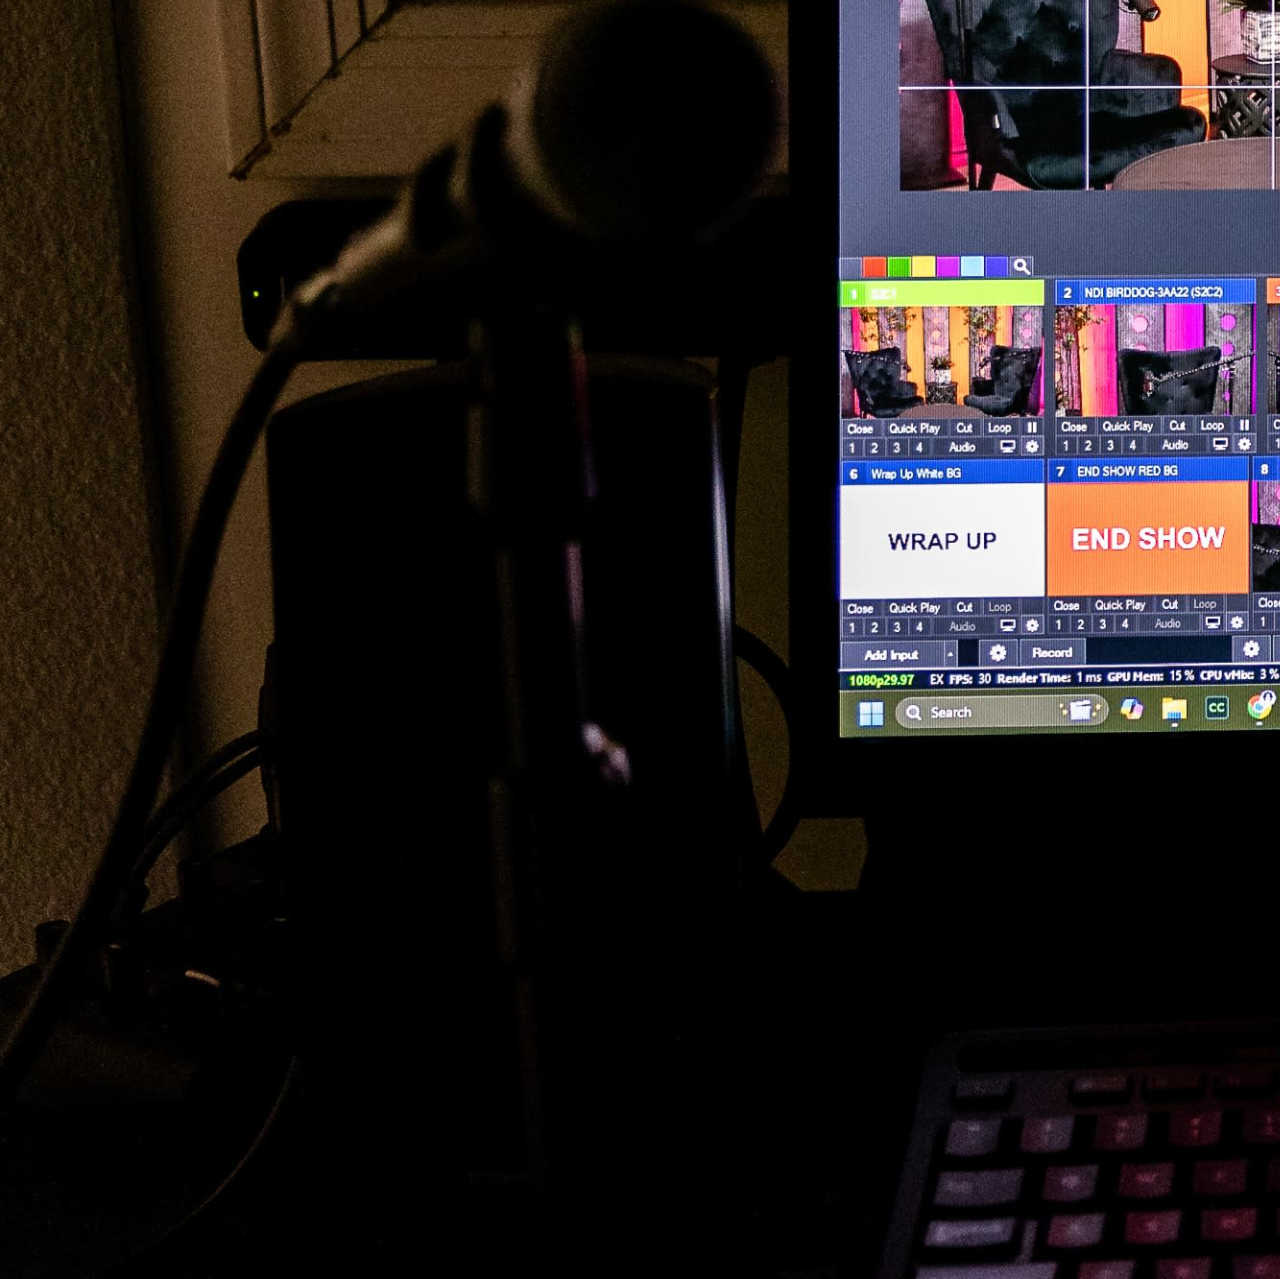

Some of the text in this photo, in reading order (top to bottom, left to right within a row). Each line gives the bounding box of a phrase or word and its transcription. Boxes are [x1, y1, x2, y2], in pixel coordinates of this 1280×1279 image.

[1064, 288, 1072, 298] 2
[1085, 287, 1103, 297] NDI
[1191, 286, 1223, 298] (S2C2)
[847, 423, 1011, 436] Close Quick Play Cut Loop
[949, 442, 976, 453] Audio
[850, 468, 961, 481] 6 Wrap Up White BG
[1056, 466, 1178, 477] 7 END SHOW RED BG
[1261, 464, 1268, 474] 8
[888, 532, 997, 550] WRAP UP
[1072, 526, 1225, 550] END SHOW
[864, 649, 919, 661] Add Input
[1033, 648, 1073, 658] Record
[849, 674, 915, 688] 1080p29.97
[930, 674, 944, 684] EX
[950, 674, 973, 684] FPS:
[979, 674, 992, 684] 30
[997, 674, 1038, 684] Render
[1040, 673, 1071, 683] Time:
[1086, 675, 1102, 683] ms
[1107, 672, 1131, 682] GPU
[1133, 671, 1164, 682] Mem:
[1170, 671, 1182, 681] 15
[1184, 671, 1194, 681] %
[1200, 670, 1223, 680] CPU
[1260, 669, 1267, 679] 3
[1269, 669, 1279, 679] %
[931, 707, 972, 718] Search
[1209, 703, 1225, 713] CC
